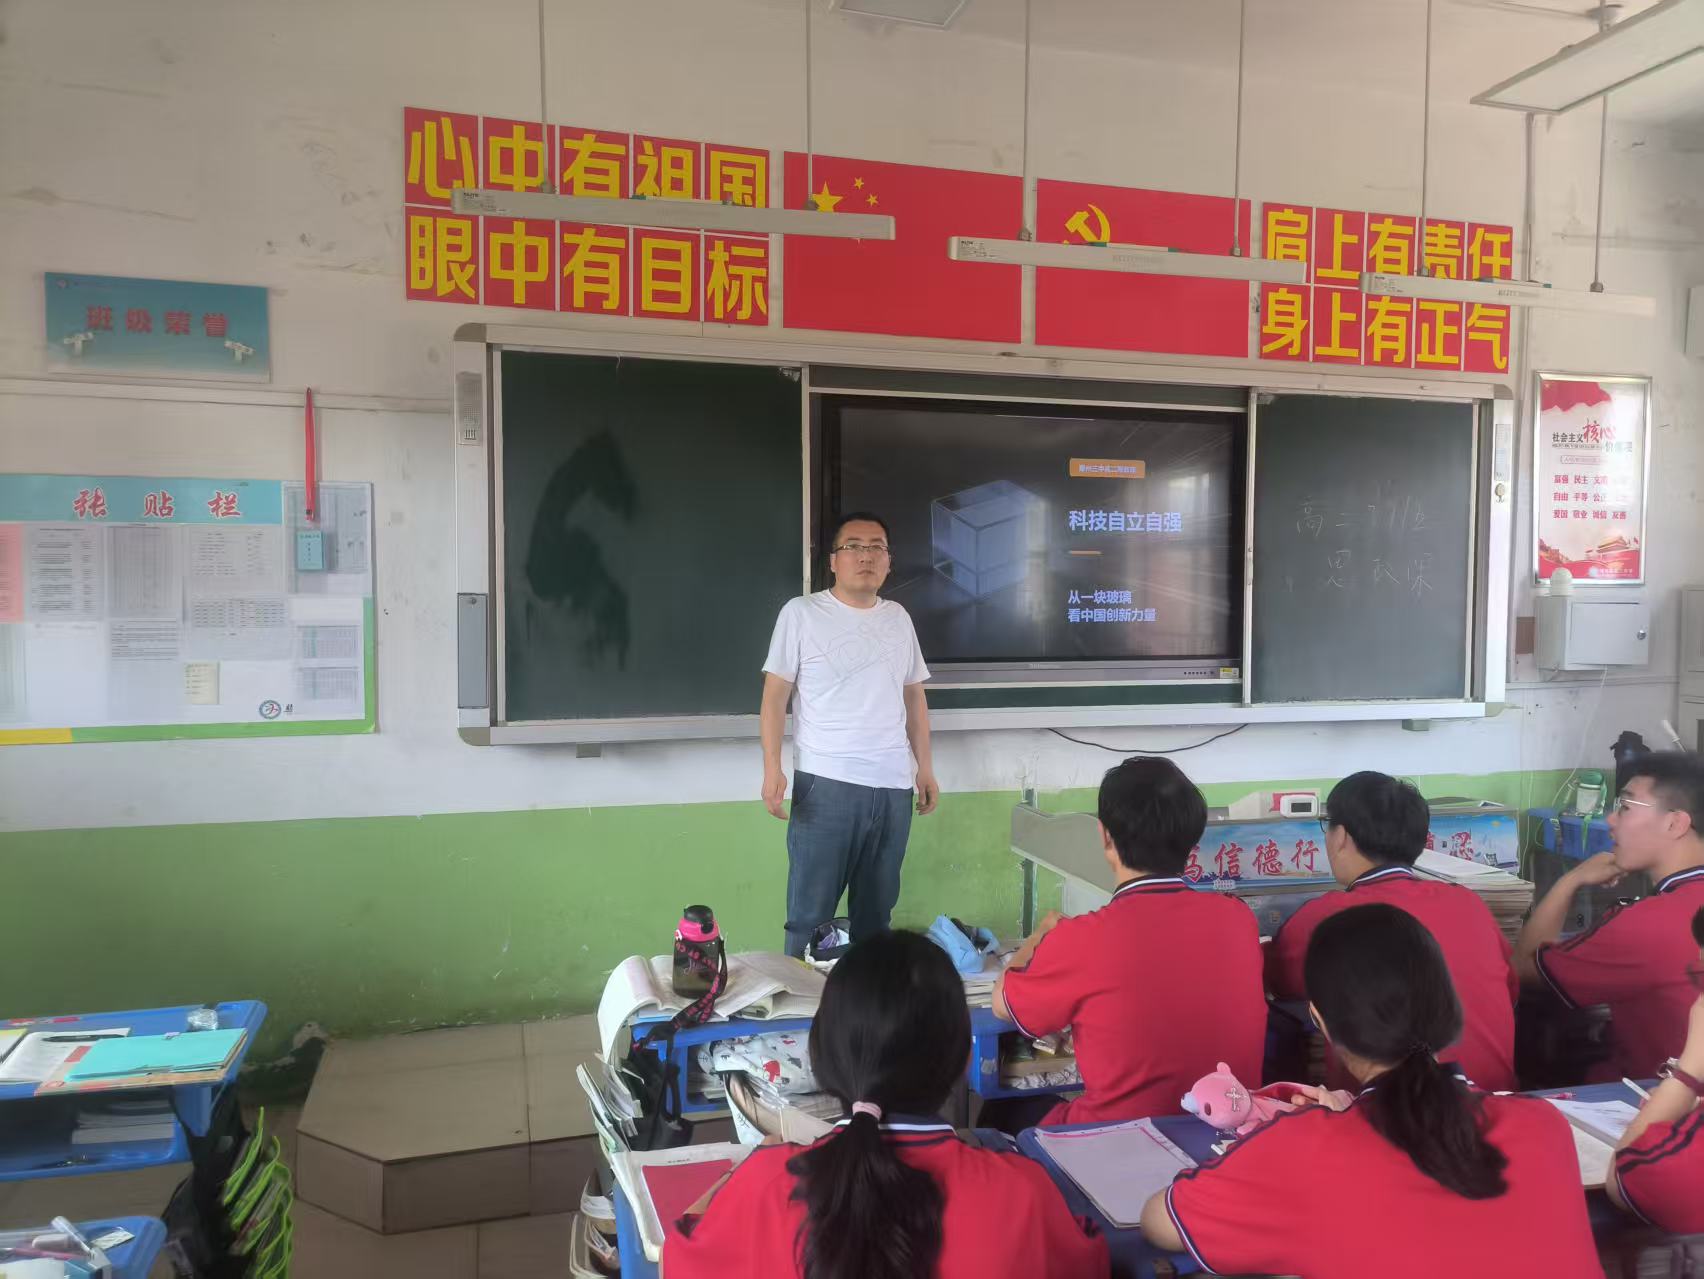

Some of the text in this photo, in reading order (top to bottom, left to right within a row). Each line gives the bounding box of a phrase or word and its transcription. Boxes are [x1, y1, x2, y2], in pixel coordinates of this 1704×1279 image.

[407, 116, 768, 208] 心中有祖国
[1267, 208, 1511, 281] 肩上有责任
[408, 215, 768, 320] 眼中有目标
[86, 304, 228, 337] 班级荣誉
[1262, 287, 1507, 370] 身上有正气
[1552, 431, 1584, 443] 社会主义
[1573, 475, 1589, 484] 民主
[73, 487, 241, 519] 张贴栏
[1553, 492, 1569, 501] 自由
[1573, 492, 1588, 502] 平等
[1068, 509, 1183, 532] 科技自立自强
[1552, 509, 1568, 519] 爱国
[1067, 589, 1132, 605] 从一块玻璃
[1067, 607, 1157, 623] 看中国创新力量
